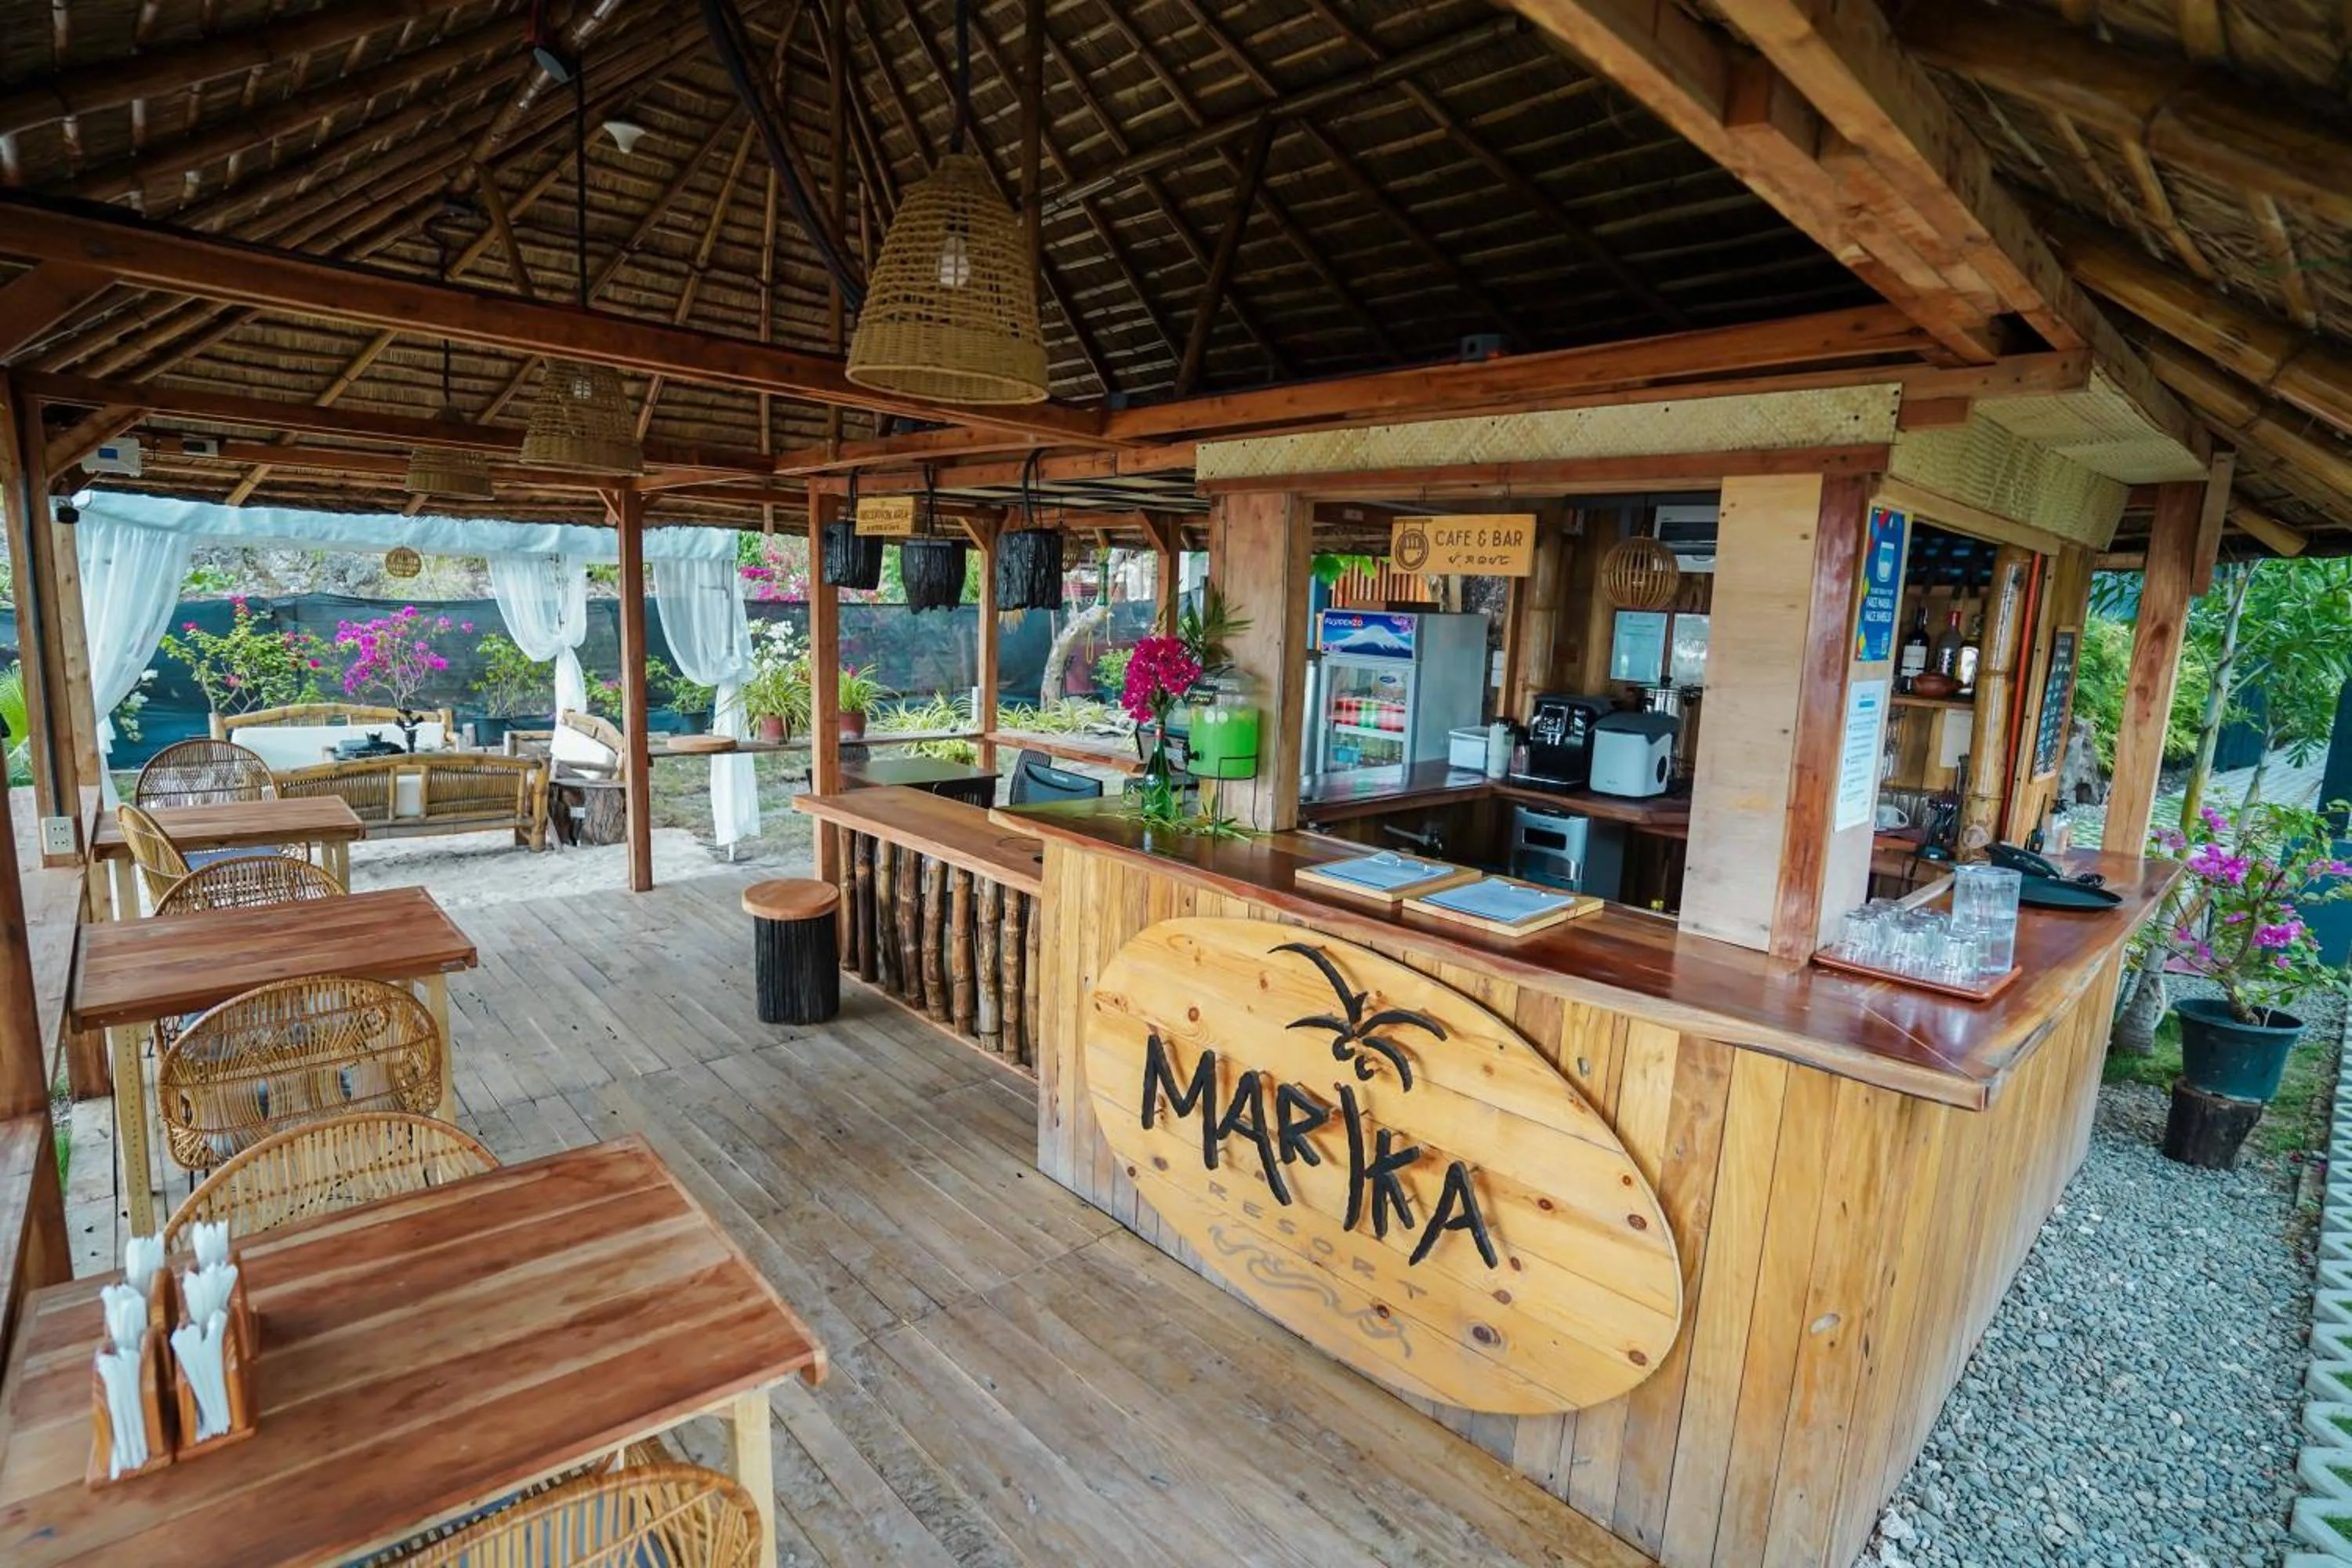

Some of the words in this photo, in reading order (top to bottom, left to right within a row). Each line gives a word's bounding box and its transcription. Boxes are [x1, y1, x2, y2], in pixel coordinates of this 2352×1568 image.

[1435, 529, 1473, 547] CAFE
[1477, 528, 1487, 548] &
[1492, 529, 1523, 547] BAR
[1141, 1033, 1498, 1270] MARIKA
[1207, 1180, 1428, 1301] RESORT
